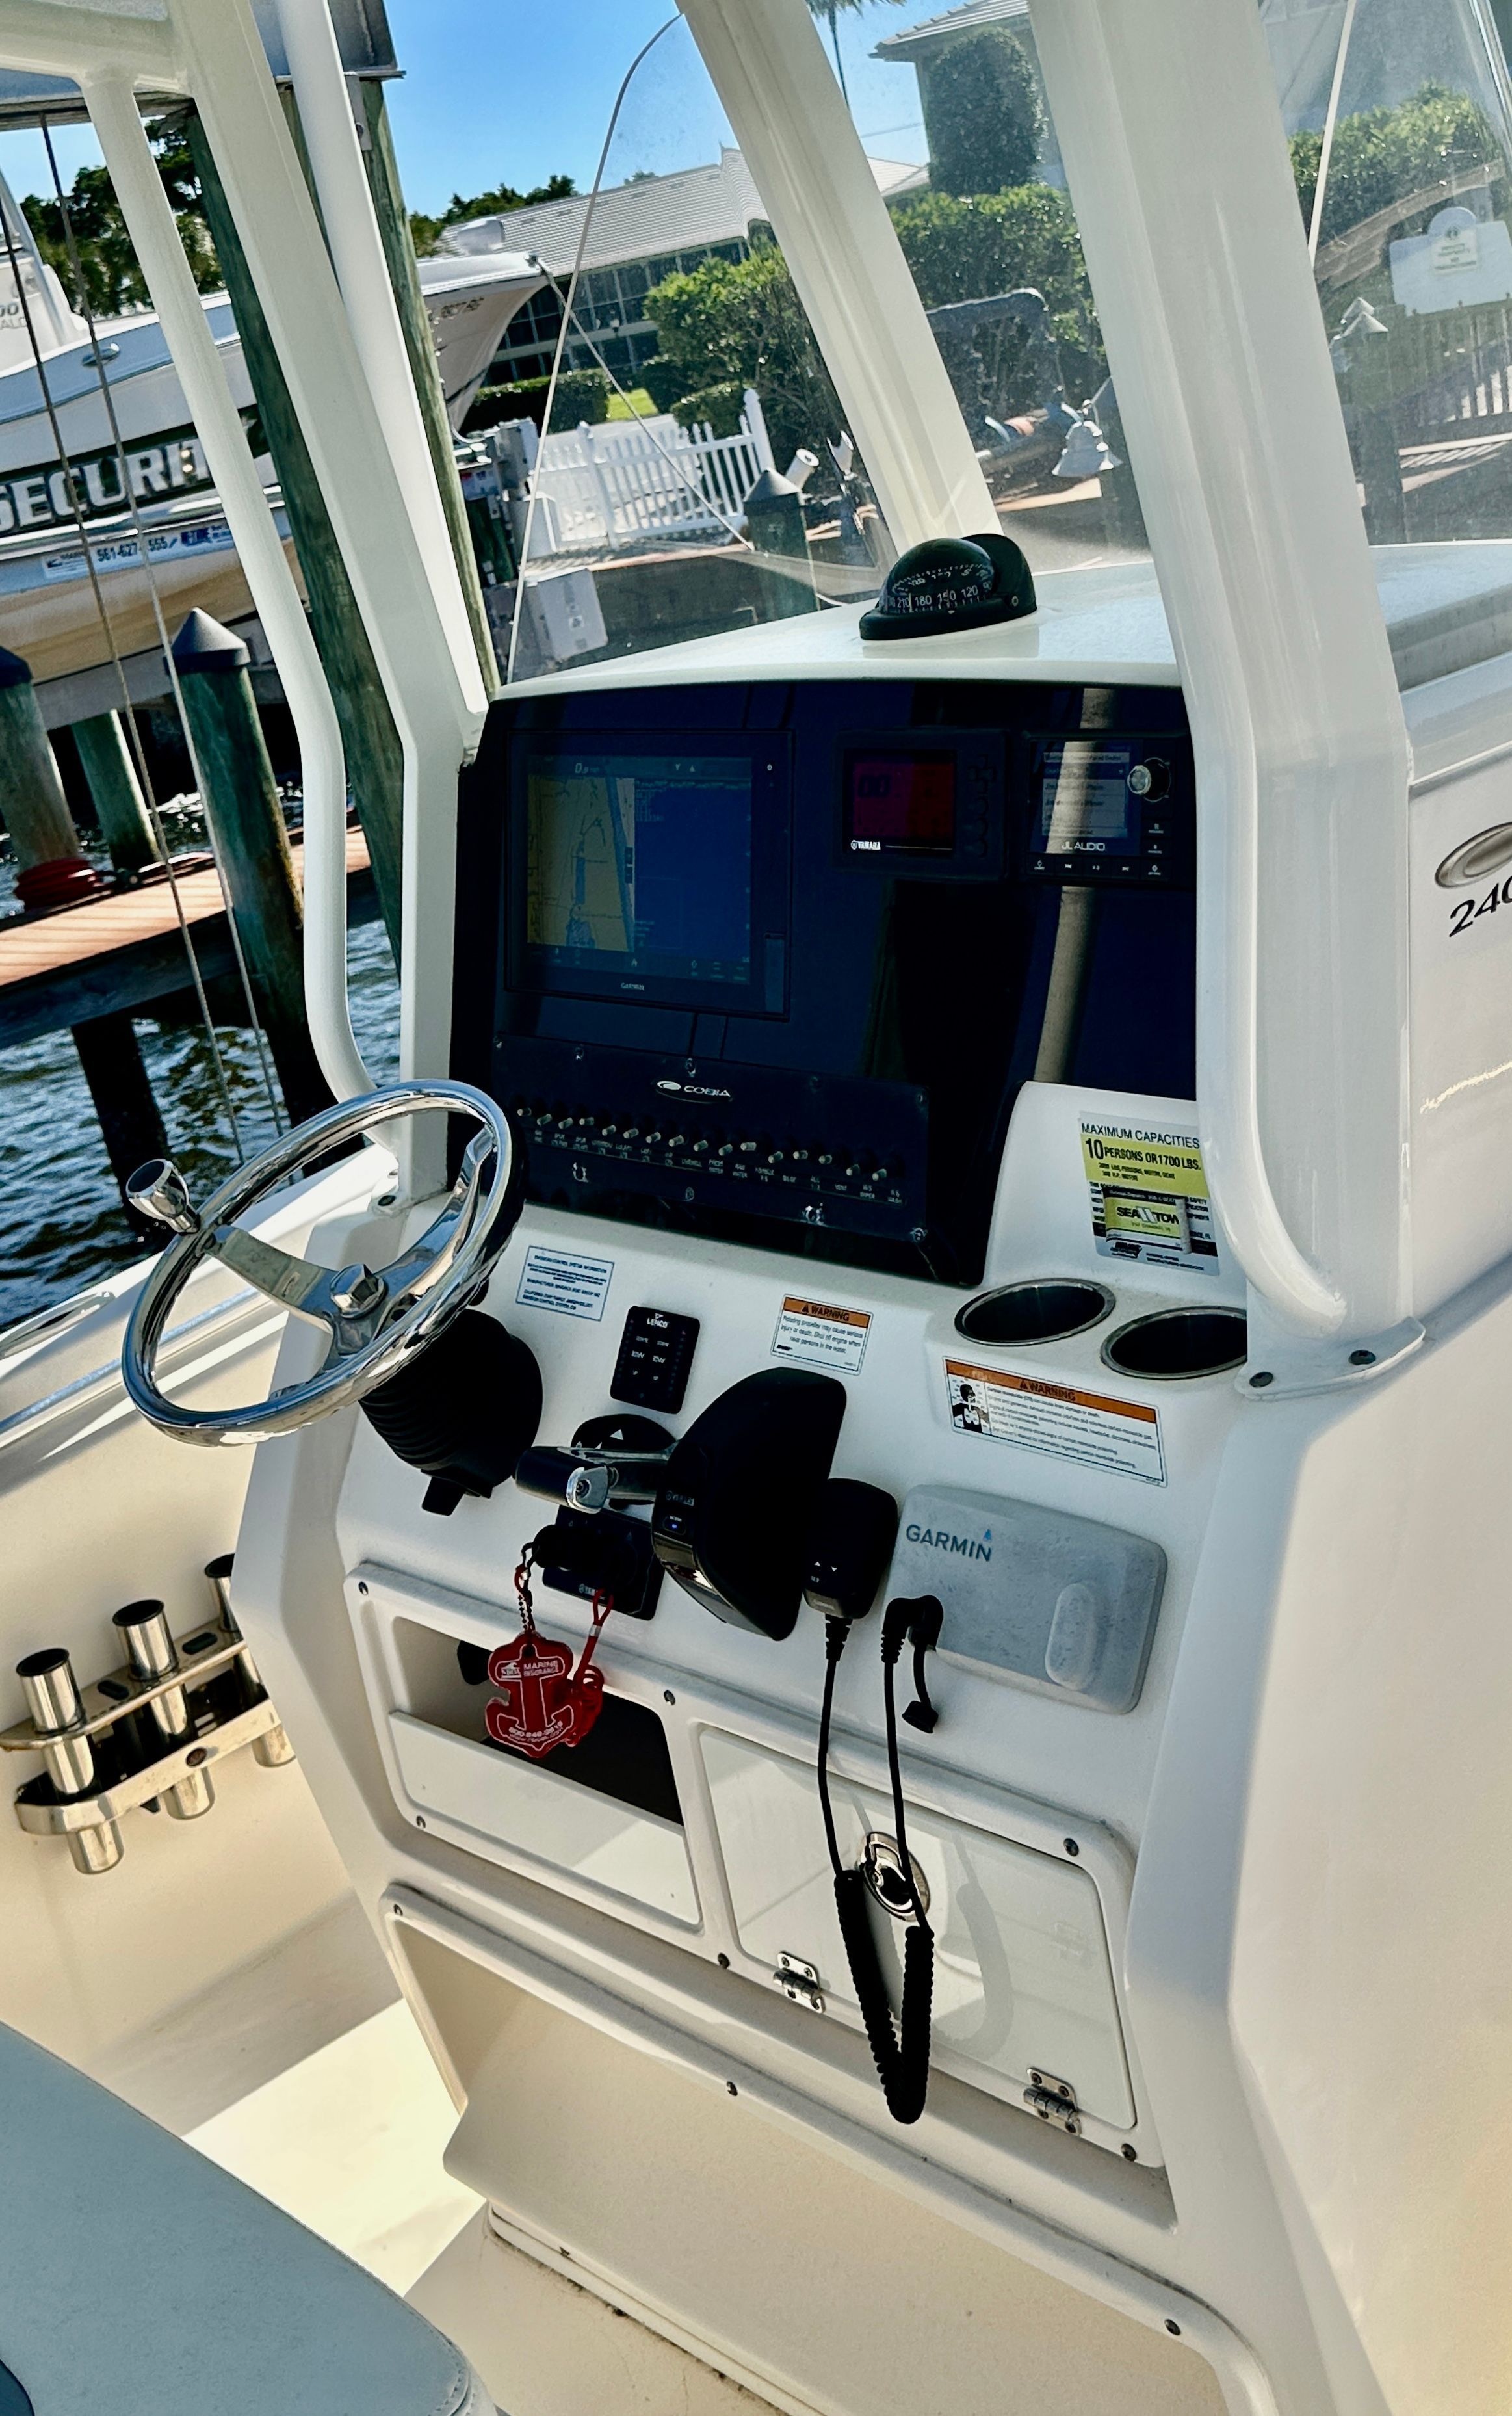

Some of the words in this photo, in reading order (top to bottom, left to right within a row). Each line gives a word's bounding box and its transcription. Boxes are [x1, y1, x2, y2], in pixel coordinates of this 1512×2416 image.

[915, 594, 932, 607] 180
[961, 585, 978, 597] 120
[1074, 841, 1106, 852] AUDIO
[1081, 1123, 1133, 1140] MAXIMUM
[1135, 1130, 1201, 1149] CAPACITIES
[1085, 1137, 1104, 1160] 10
[1104, 1146, 1143, 1162] PERSONS
[1116, 1206, 1141, 1220] SEA
[811, 1304, 850, 1322] WARNING
[1029, 1381, 1076, 1402] WARNING
[906, 1523, 993, 1562] GARMIN
[523, 1660, 558, 1670] MARINE
